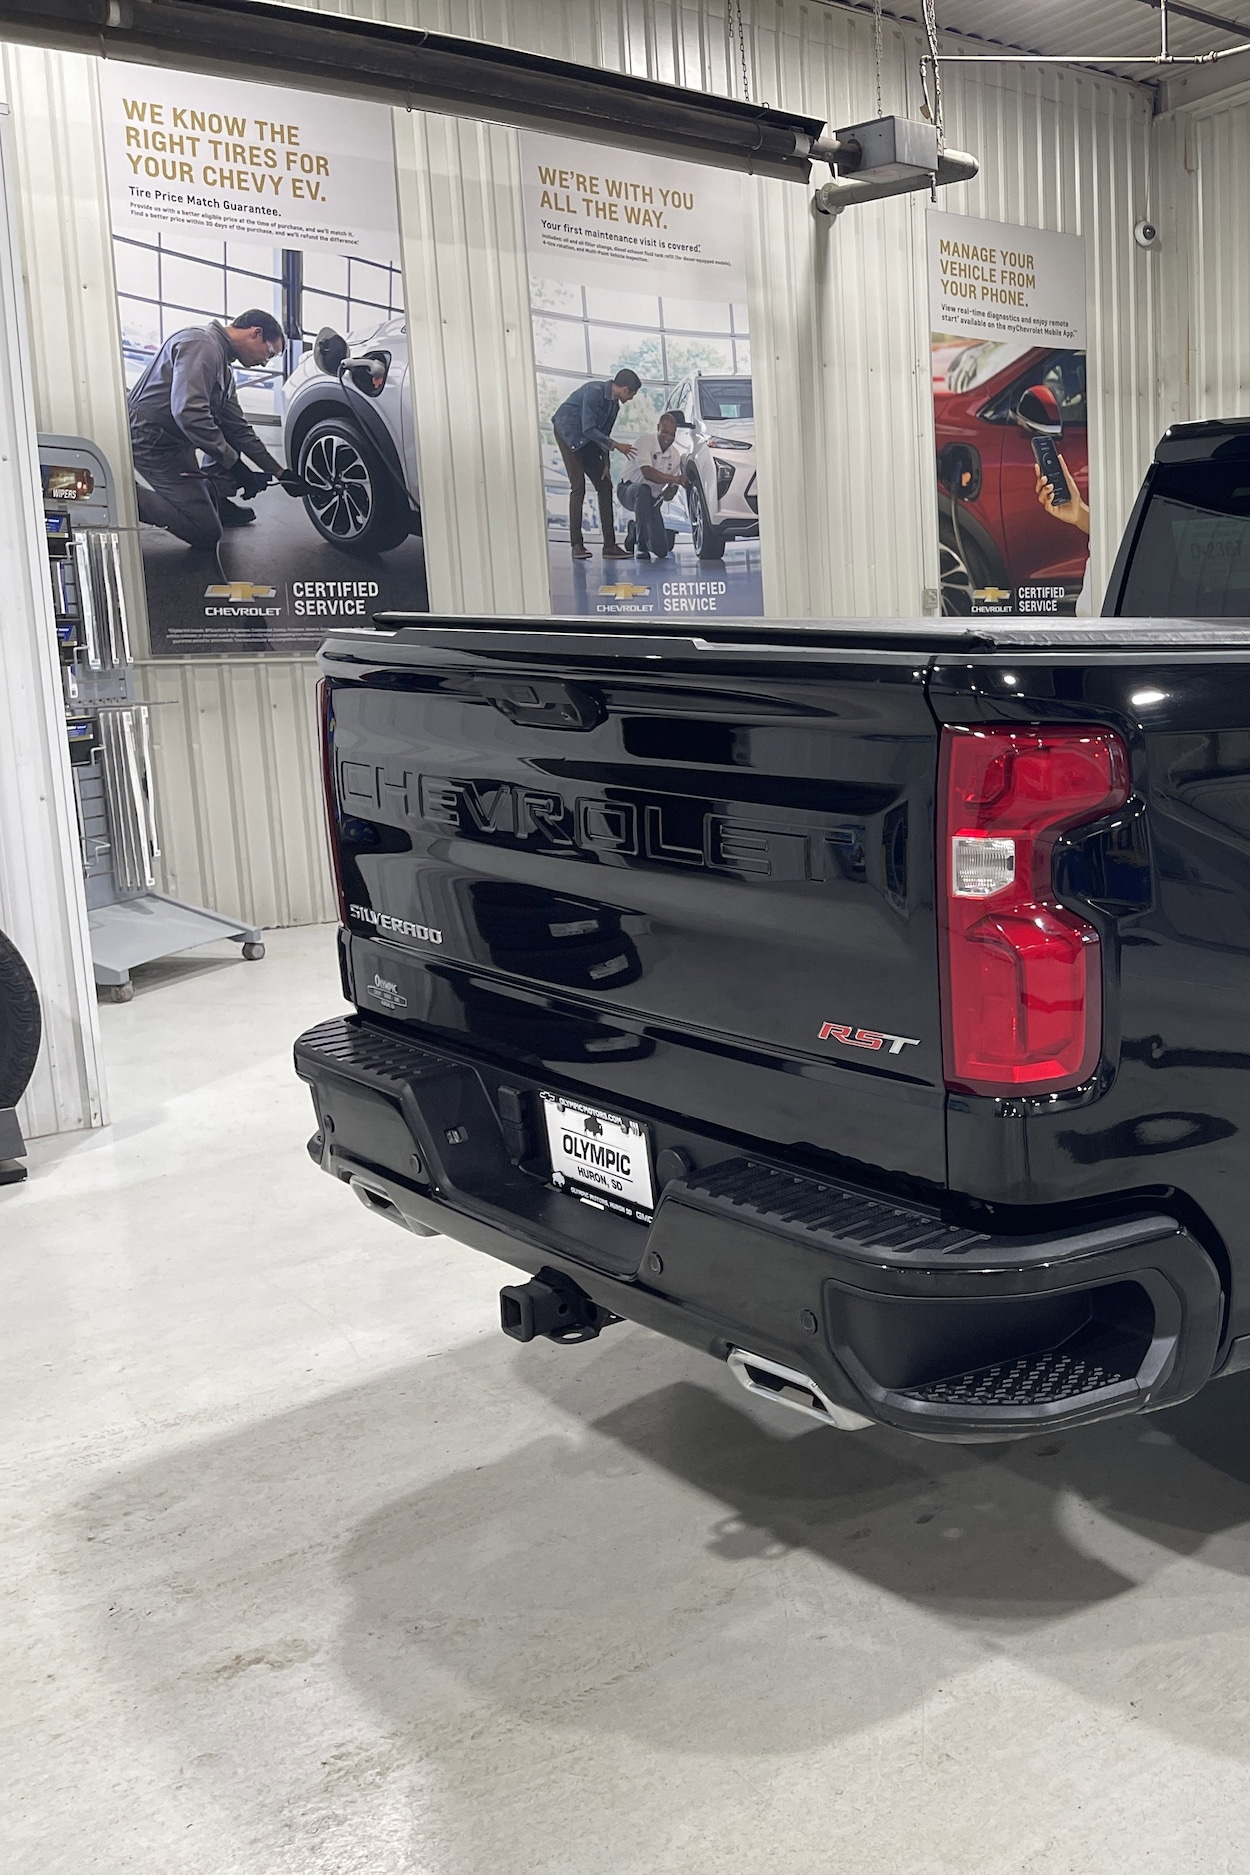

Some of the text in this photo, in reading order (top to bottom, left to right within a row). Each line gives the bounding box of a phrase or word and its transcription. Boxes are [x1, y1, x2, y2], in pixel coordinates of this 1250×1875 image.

[122, 99, 300, 146] WE KNOW THE
[126, 126, 330, 176] RIGHT TIRES FOR
[126, 153, 326, 202] YOUR CHEVY EV.
[538, 166, 694, 211] WE'RE WITH YOU
[129, 186, 282, 217] Tire Price Match Guarantee.
[130, 202, 153, 211] Provide
[163, 206, 175, 214] with
[182, 209, 200, 217] better
[202, 212, 222, 221] eligible
[224, 215, 238, 223] price
[540, 191, 668, 230] ALL THE WAY.
[541, 219, 561, 231] Your
[564, 224, 583, 236] first
[585, 230, 638, 245] maintenance
[640, 237, 657, 247] visit
[659, 240, 665, 249] is
[940, 239, 1034, 270] MANAGE YOUR
[940, 259, 1036, 289] VEHICLE FROM
[941, 279, 1029, 308] YOUR PHONE.
[941, 303, 1069, 328] View real-time diagnostics and enjoy remote
[961, 317, 986, 328] available
[996, 322, 1006, 331] the
[1008, 324, 1043, 335] myChevrolet
[1044, 327, 1062, 337] Mobile
[52, 489, 77, 499] WIPERS
[293, 582, 379, 598] CERTIFIED
[662, 582, 726, 596] CERTIFIED
[1018, 586, 1065, 599] CERTIFIED
[204, 607, 282, 617] CHEVROLET
[294, 600, 366, 616] SERVICE
[597, 604, 654, 613] CHEVROLET
[663, 598, 717, 612] SERVICE
[1019, 600, 1058, 612] SERVICE
[340, 760, 868, 882] CHEVROLET
[350, 904, 443, 944] SILVERADO
[817, 1020, 920, 1055] RST
[559, 1097, 622, 1124] OLYMPICMOTORS.COM
[563, 1134, 631, 1176] OLYMPIC
[578, 1166, 623, 1191] HURON, SD
[636, 1211, 654, 1224] GMC
